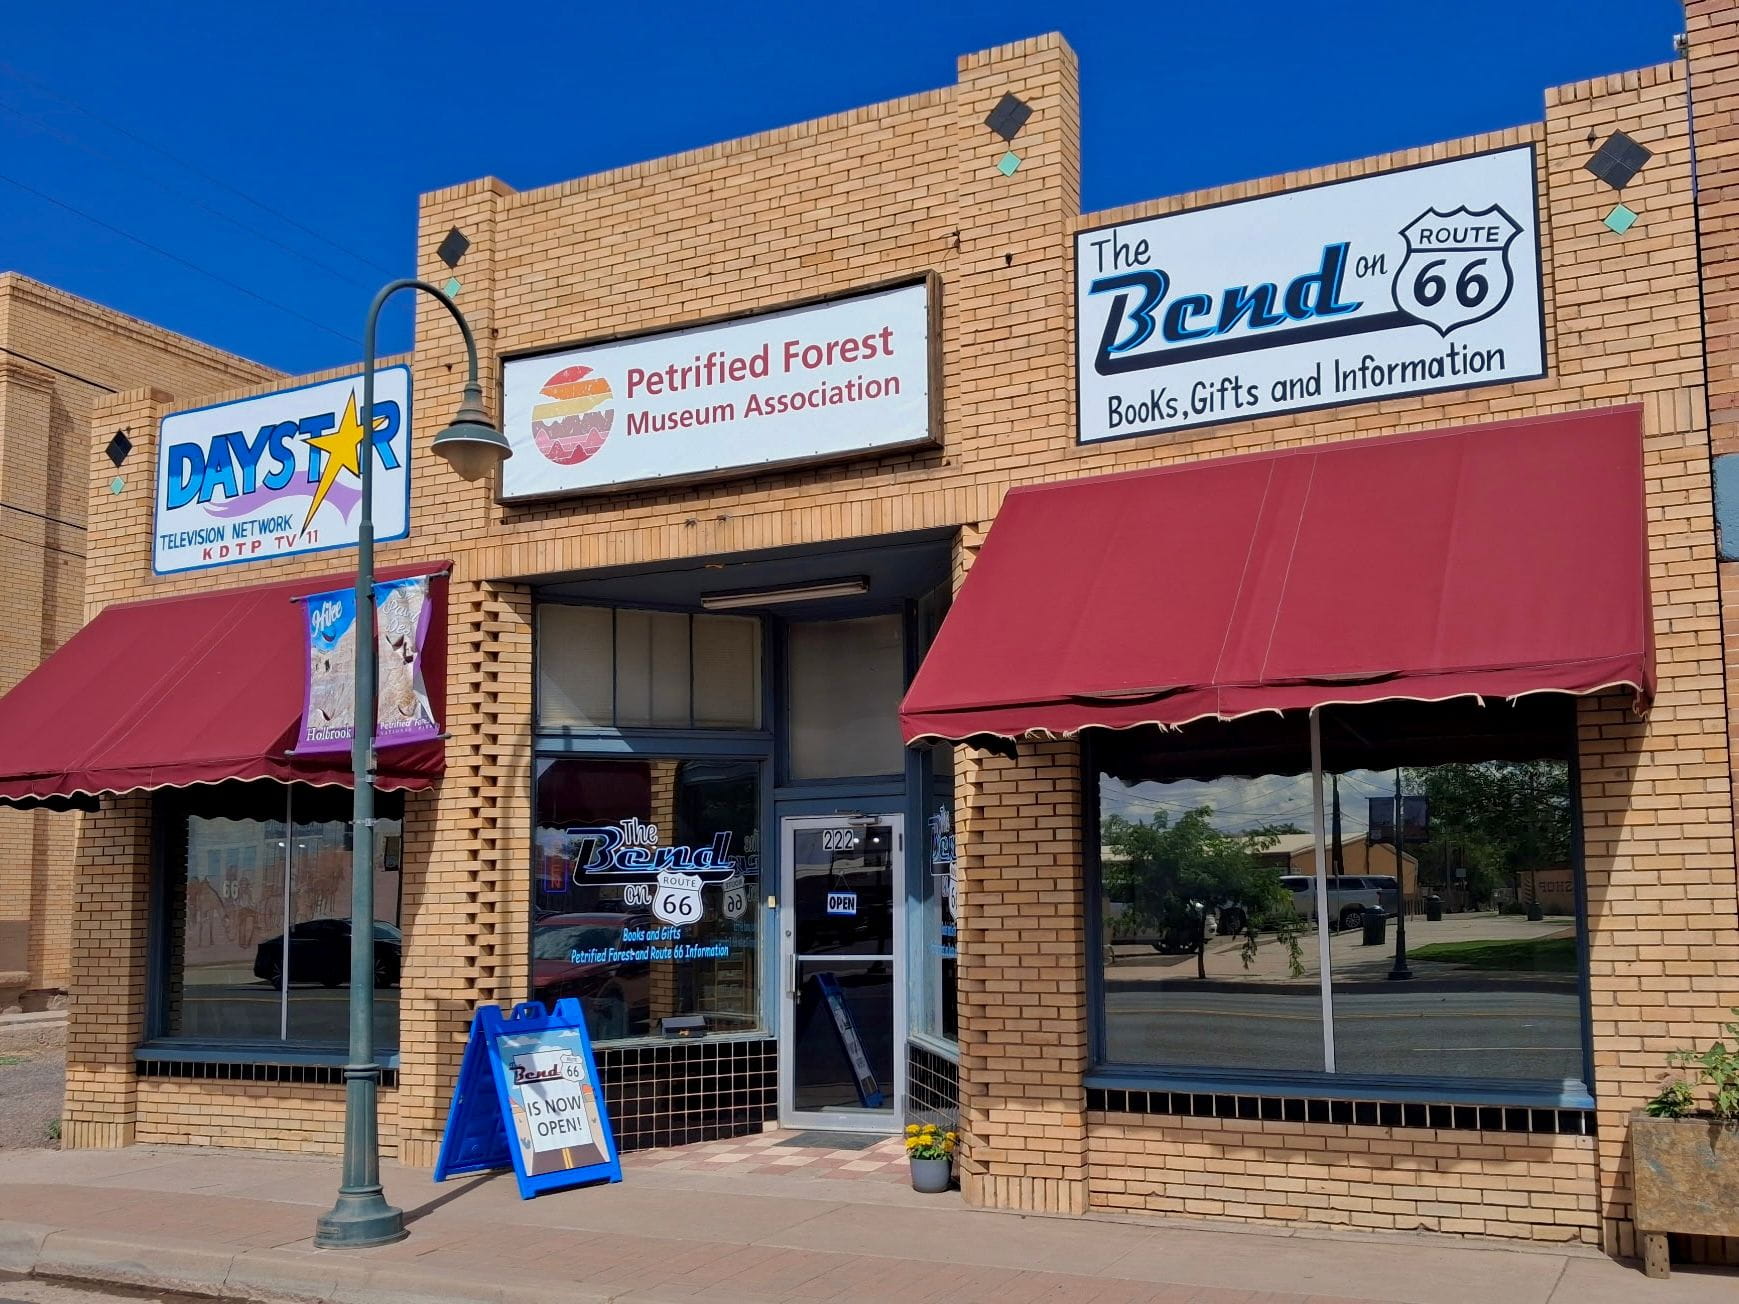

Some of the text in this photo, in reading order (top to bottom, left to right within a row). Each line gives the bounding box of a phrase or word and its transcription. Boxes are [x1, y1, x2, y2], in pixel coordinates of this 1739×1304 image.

[1418, 225, 1501, 245] ROUTE
[1090, 228, 1151, 273] The
[1412, 257, 1490, 308] 66
[1088, 240, 1388, 356] Bend on
[626, 325, 895, 399] Petrified Forest
[1271, 362, 1322, 402] and
[1334, 341, 1506, 393] Information
[626, 374, 900, 436] Museum Association
[159, 513, 294, 551] TELEVISION NETWORK
[274, 533, 298, 550] TV
[306, 529, 319, 544] 11
[311, 600, 343, 636] Hike
[306, 725, 352, 742] Holbrook
[620, 816, 659, 846] The
[824, 831, 854, 850] 222
[566, 825, 736, 872] Bend
[663, 876, 697, 888] ROUTE
[623, 883, 653, 905] on
[662, 893, 693, 916] 66
[828, 896, 855, 910] OPEN
[622, 926, 682, 942] Books and Gifts
[570, 943, 730, 964] Petrified Forest and Route 66 Information
[509, 1063, 561, 1083] Bend
[566, 1065, 580, 1077] 66
[527, 1095, 582, 1117] IS NOW
[537, 1116, 583, 1137] OPEN!
